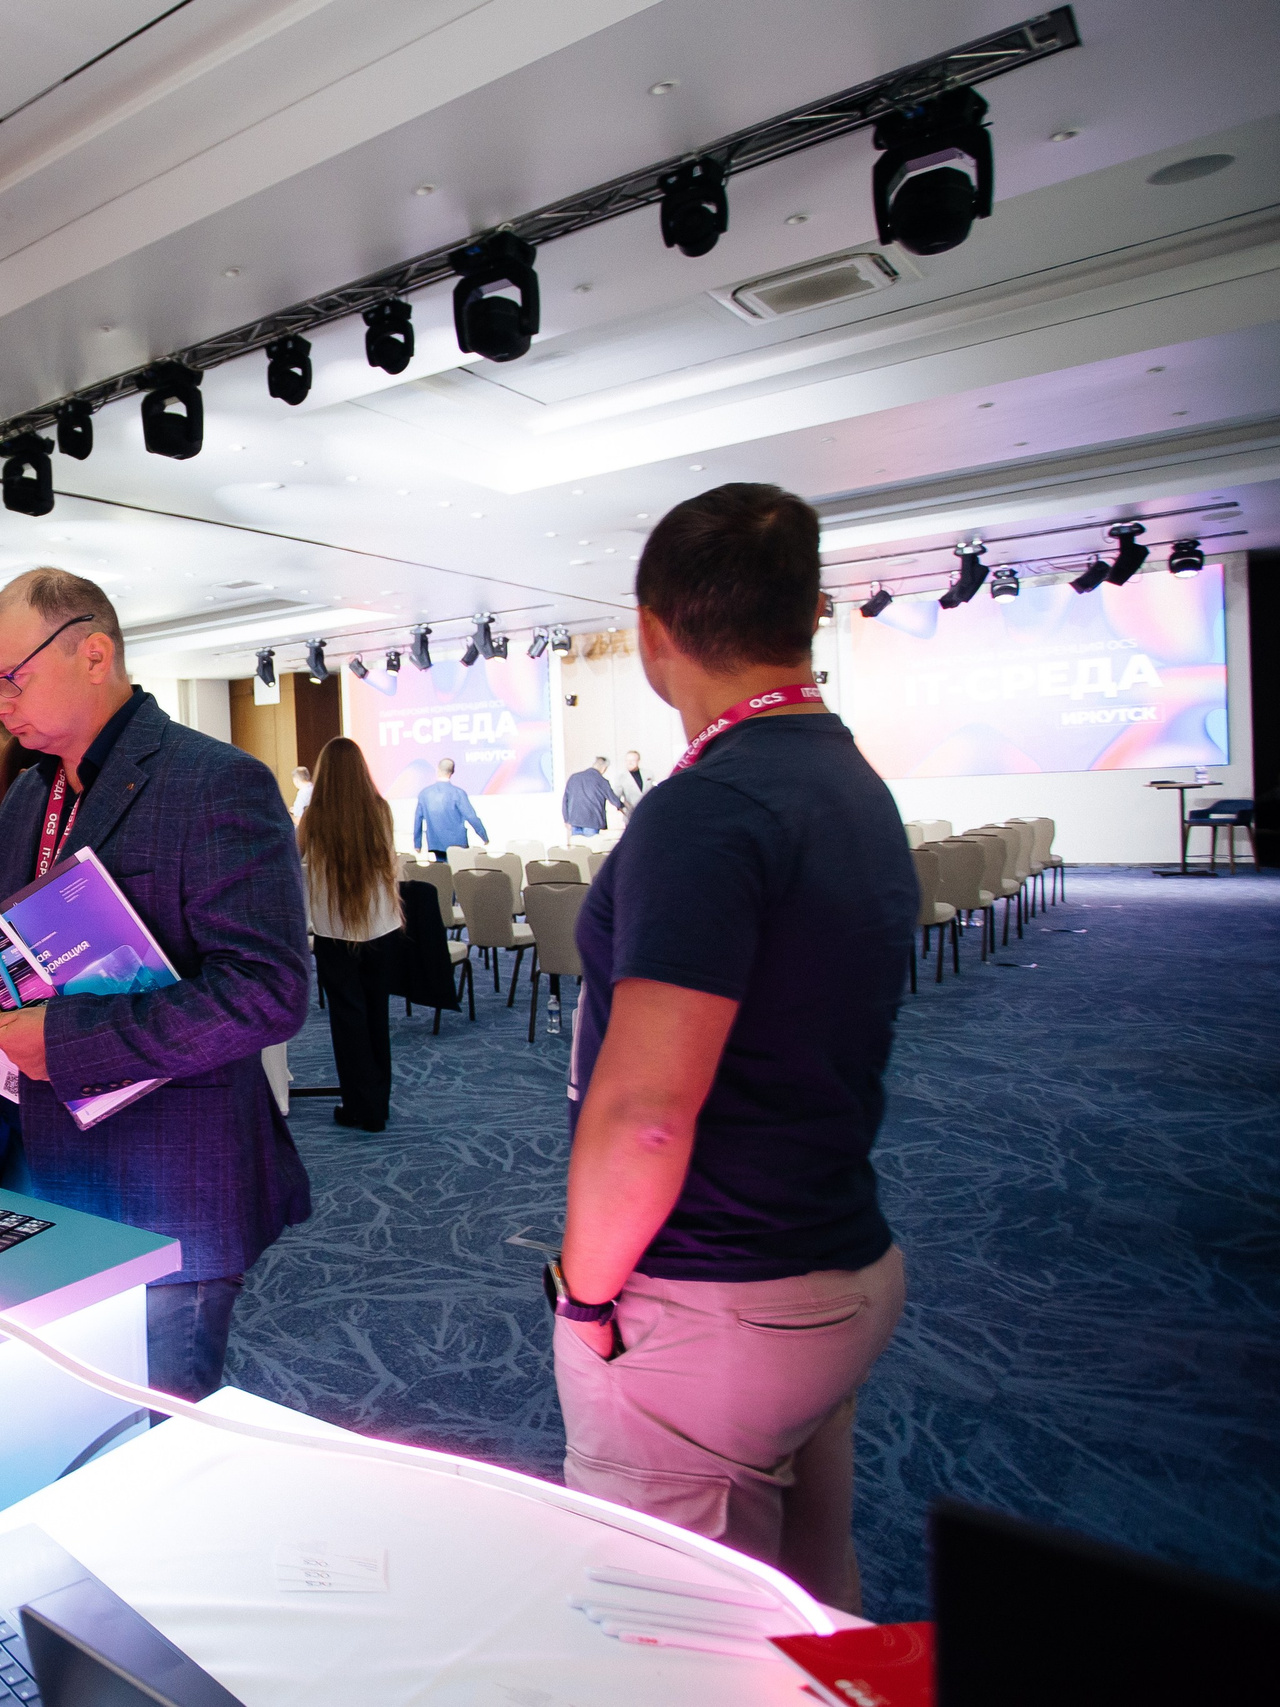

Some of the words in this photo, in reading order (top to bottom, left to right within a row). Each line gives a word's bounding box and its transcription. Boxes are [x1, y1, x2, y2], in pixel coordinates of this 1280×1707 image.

[1107, 638, 1138, 650] OCS
[904, 654, 1165, 707] IT-СРЕДА
[749, 692, 785, 709] OCS
[1061, 706, 1158, 726] ИРКУТСК
[379, 710, 519, 747] IT-СРЕДА
[53, 769, 66, 801] СРЕДА
[46, 813, 58, 835] OCS
[38, 847, 52, 878] IT-СР
[44, 940, 91, 974] ормация
